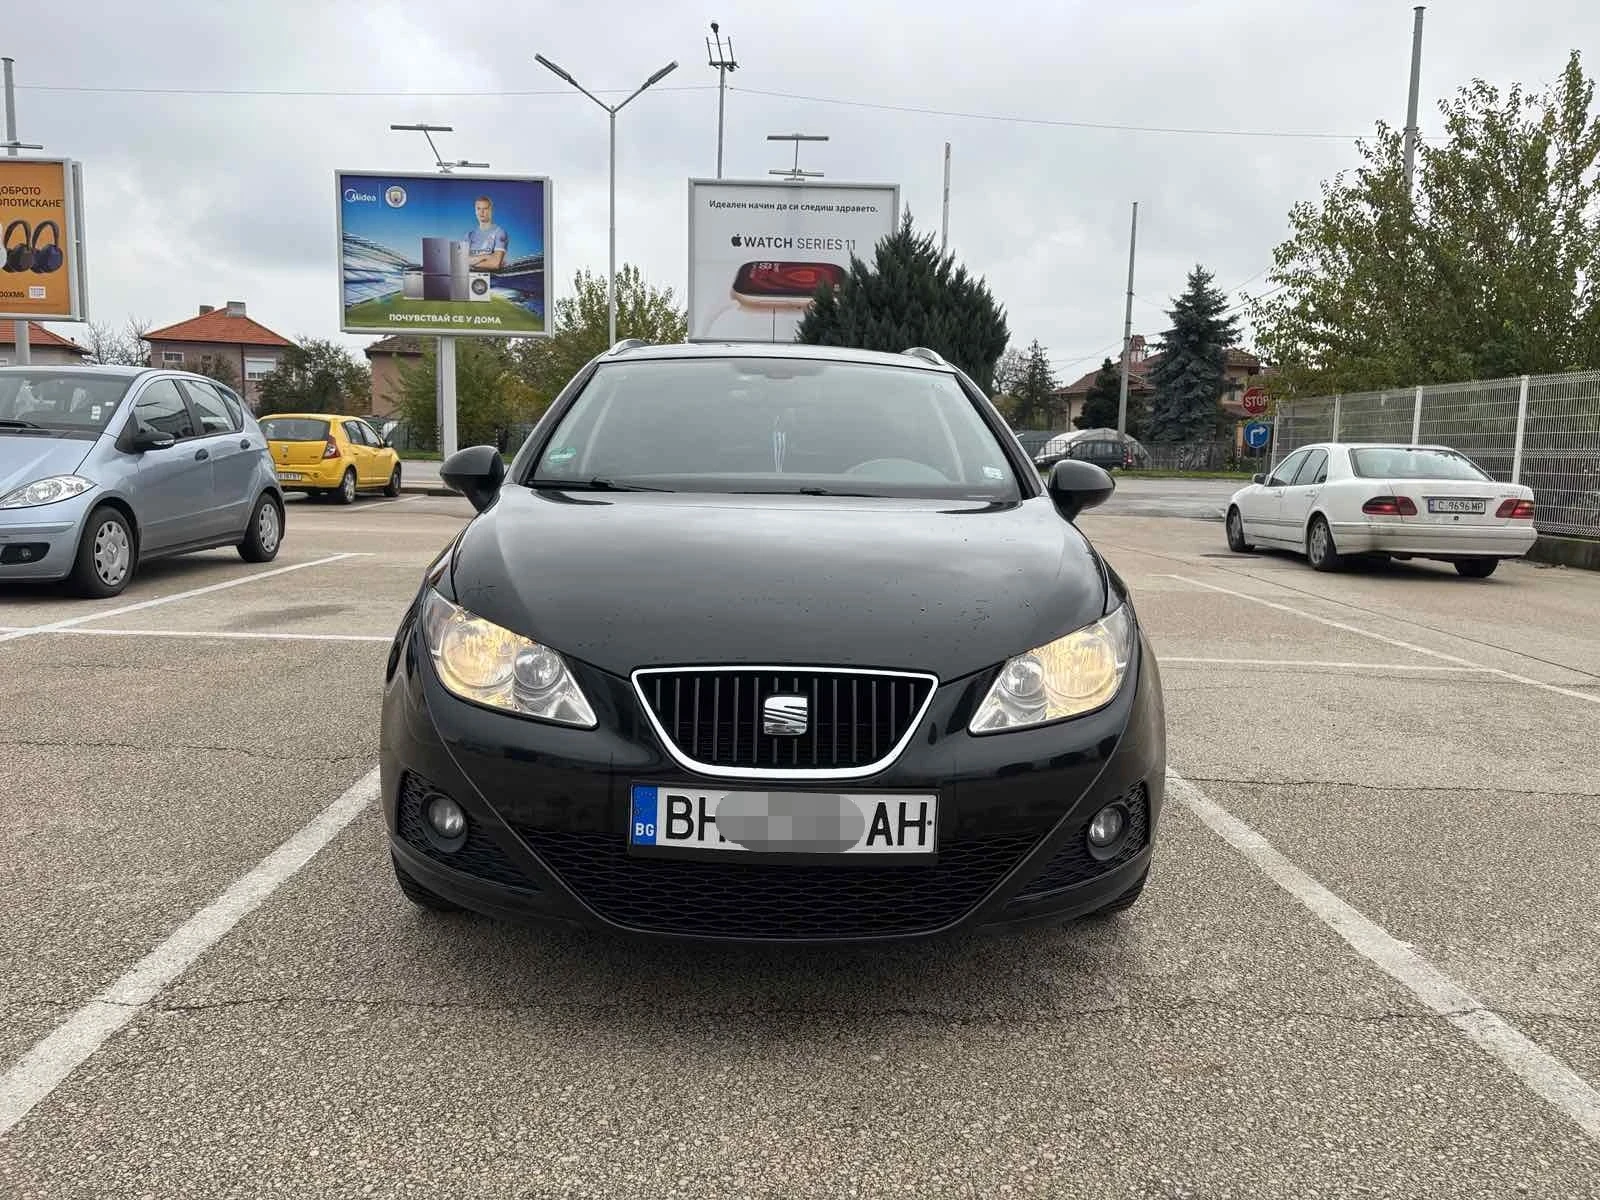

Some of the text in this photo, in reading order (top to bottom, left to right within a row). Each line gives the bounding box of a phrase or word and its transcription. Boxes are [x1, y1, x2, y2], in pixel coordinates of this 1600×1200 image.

[0, 185, 41, 195] ОБРОТО
[349, 191, 377, 202] Midea
[709, 199, 747, 209] Идеален
[748, 201, 775, 209] начин
[776, 202, 787, 211] да
[800, 203, 834, 212] следиш
[834, 205, 879, 214] здравето.
[744, 236, 856, 251] WATCH SERIES 11
[389, 313, 503, 324] ПОЧУВСТВАЙ СЕ У ДОМА
[1244, 395, 1269, 408] STOP
[1438, 499, 1446, 510] C
[635, 822, 655, 837] BG
[866, 801, 927, 847] AH
